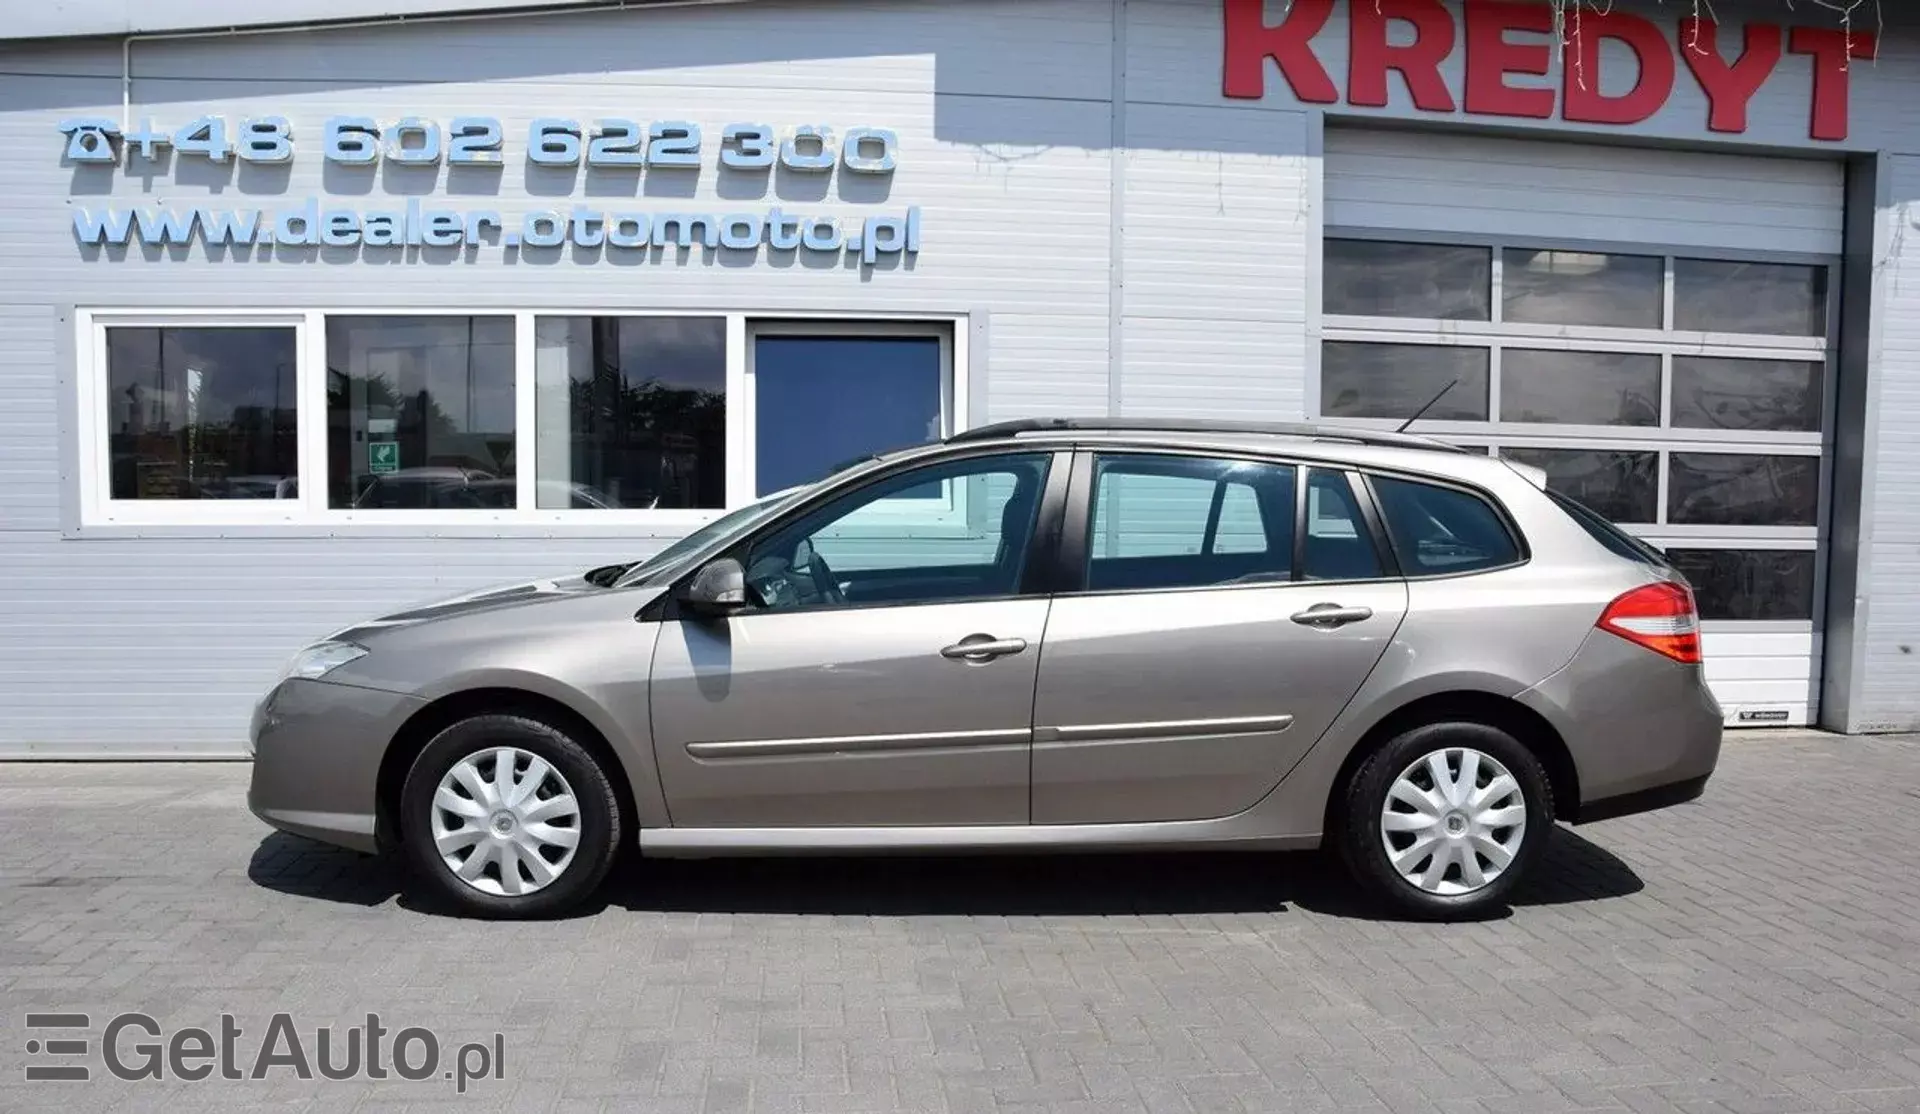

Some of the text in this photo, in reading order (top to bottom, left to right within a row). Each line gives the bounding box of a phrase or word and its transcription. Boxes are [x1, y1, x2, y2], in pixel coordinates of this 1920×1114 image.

[1223, 0, 1877, 141] KREDYT
[124, 114, 900, 175] +48 602 622 300
[71, 196, 921, 264] www.dealer.otomoto.pl
